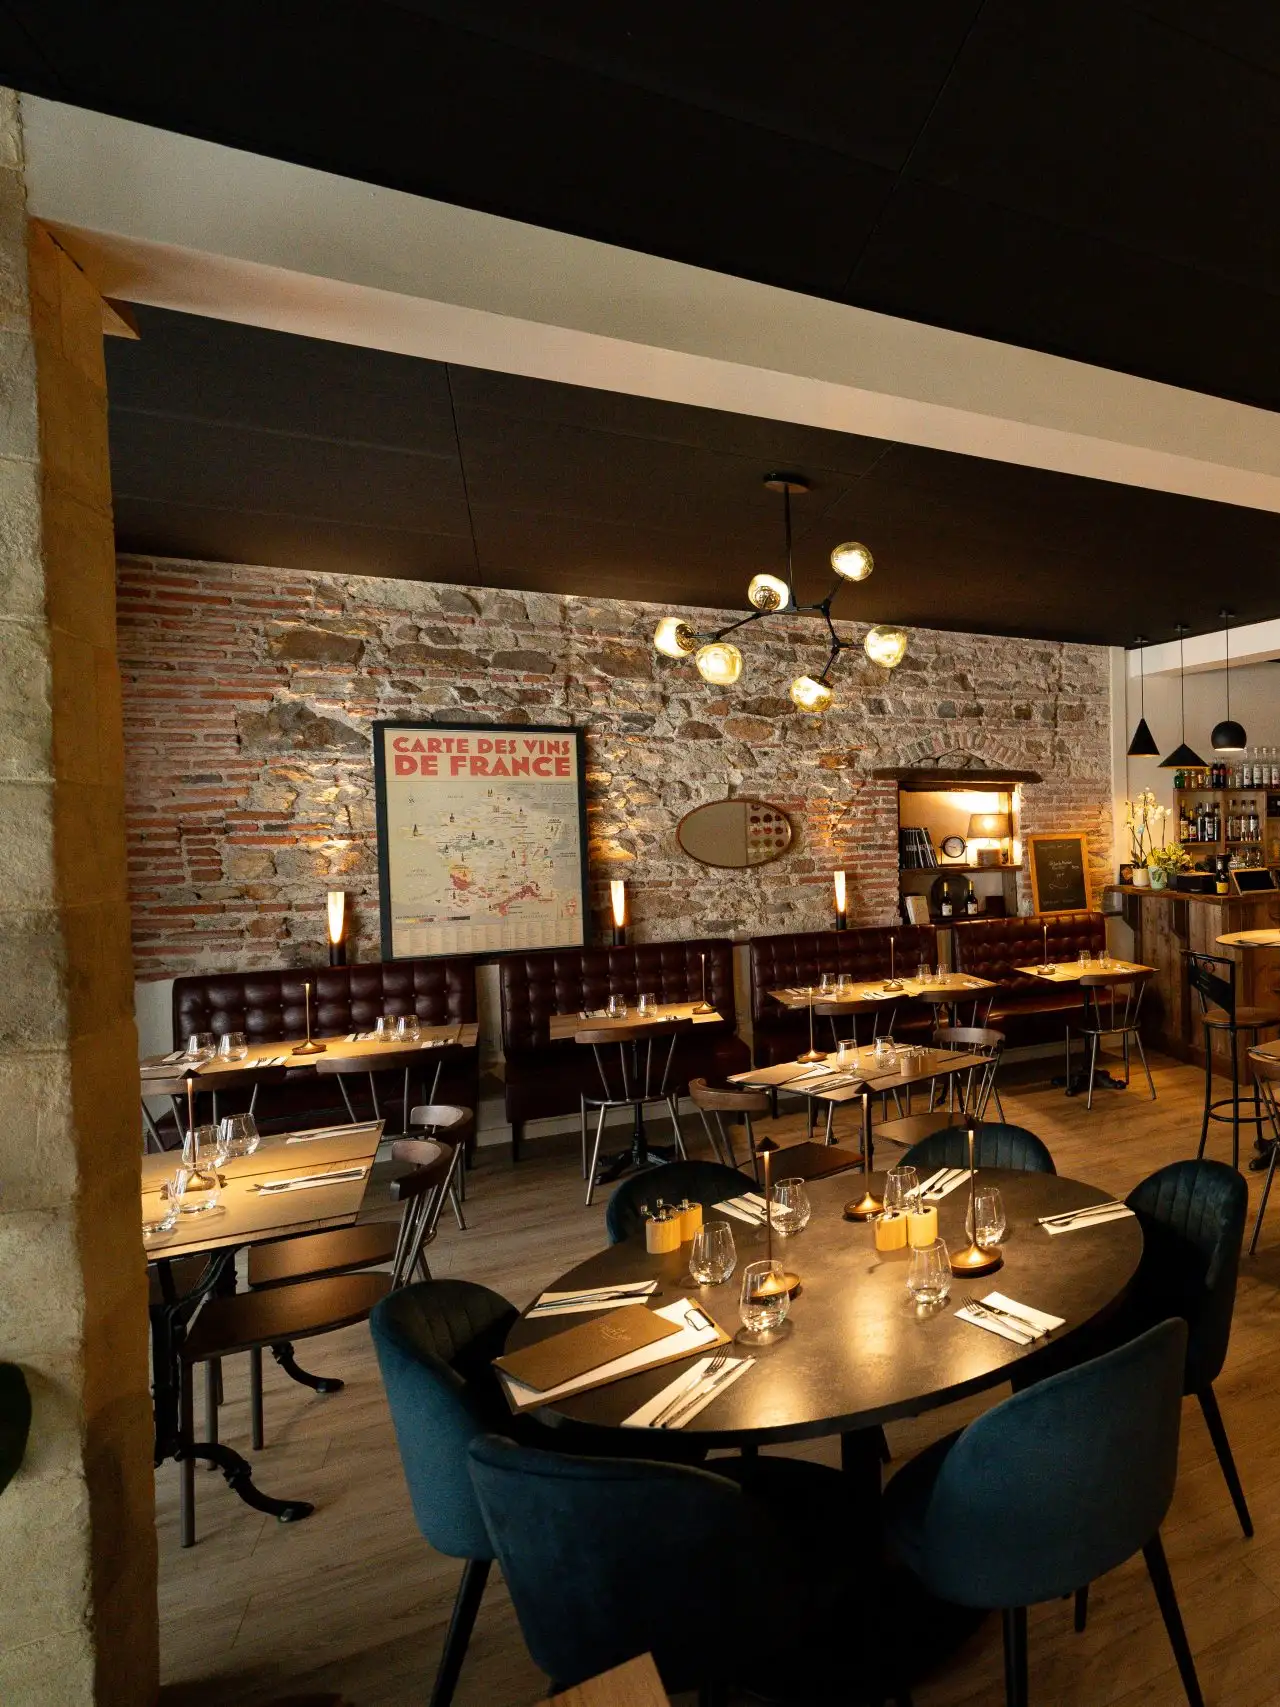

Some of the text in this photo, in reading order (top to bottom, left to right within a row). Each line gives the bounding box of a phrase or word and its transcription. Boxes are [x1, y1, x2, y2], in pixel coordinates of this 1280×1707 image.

[392, 736, 571, 755] CARTE DES VINS
[394, 755, 572, 777] DE FRANCE
